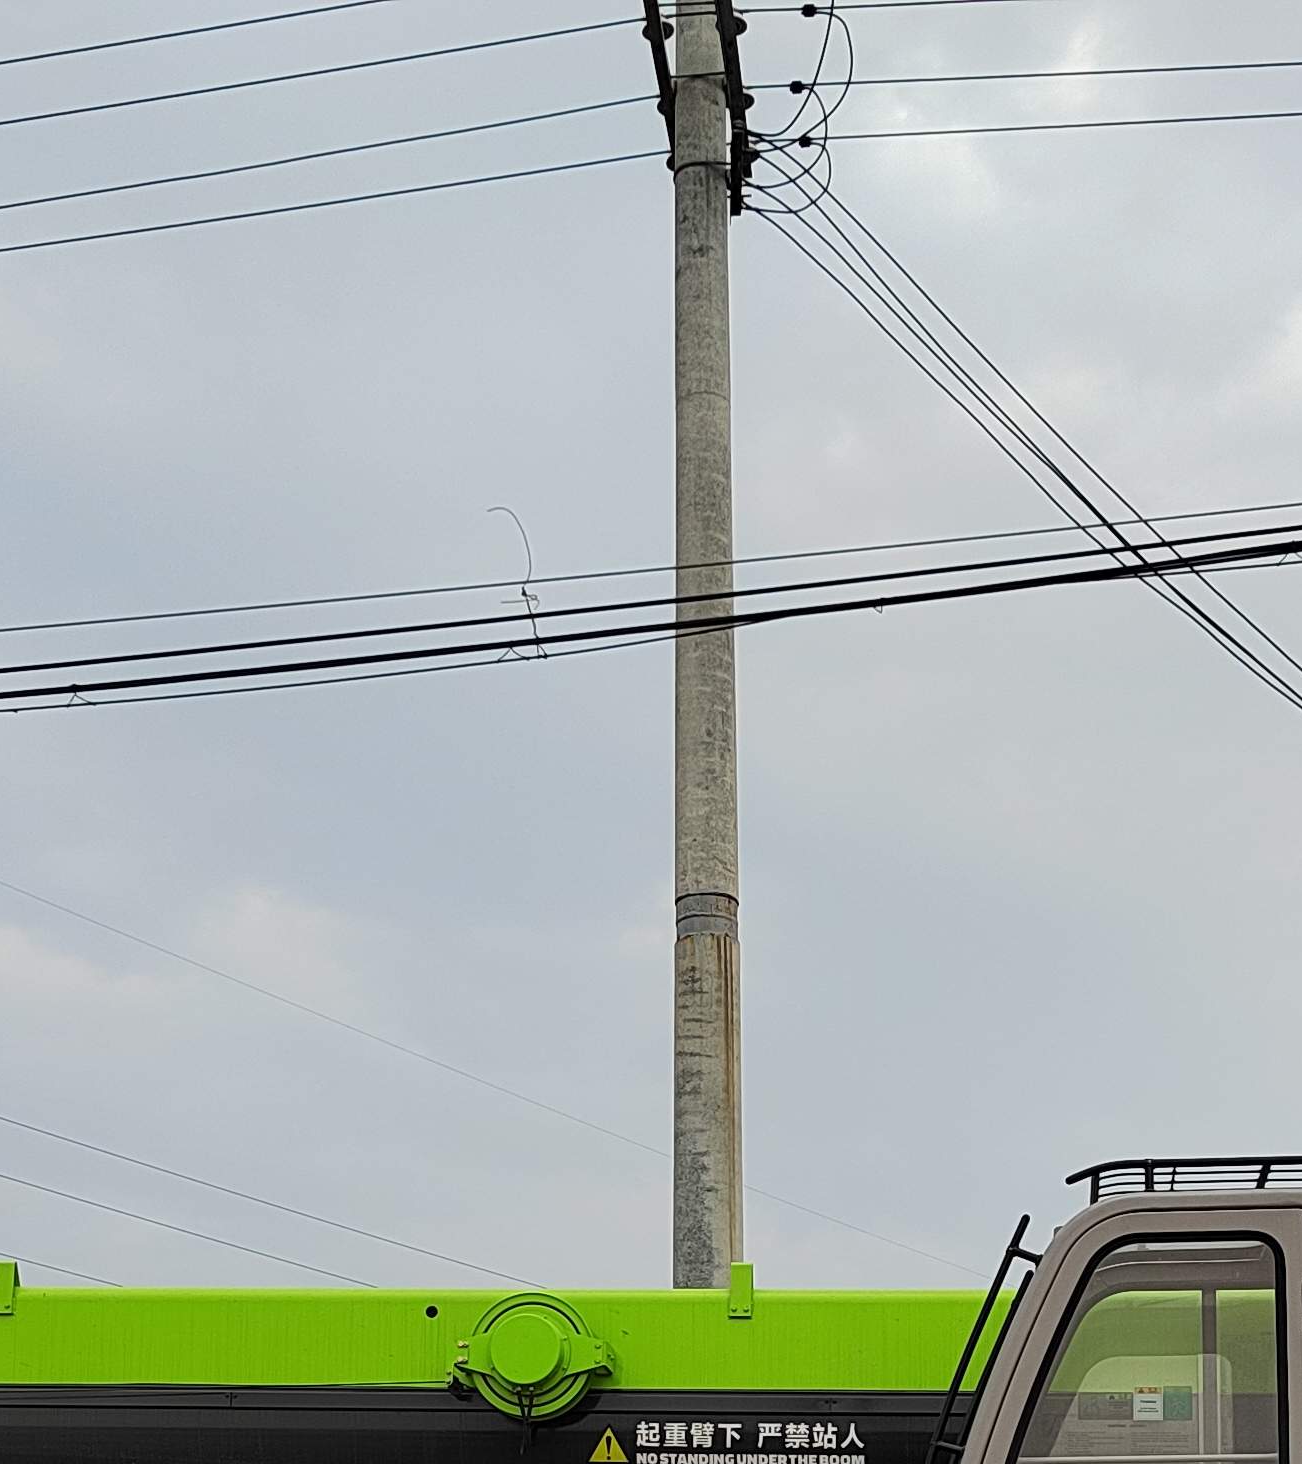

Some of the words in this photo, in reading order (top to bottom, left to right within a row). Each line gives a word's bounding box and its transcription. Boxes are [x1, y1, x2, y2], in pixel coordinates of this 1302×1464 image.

[636, 1421, 742, 1448] 起重臂下
[757, 1422, 865, 1449] 严禁站人
[636, 1453, 658, 1464] NO
[659, 1453, 734, 1464] STANDING
